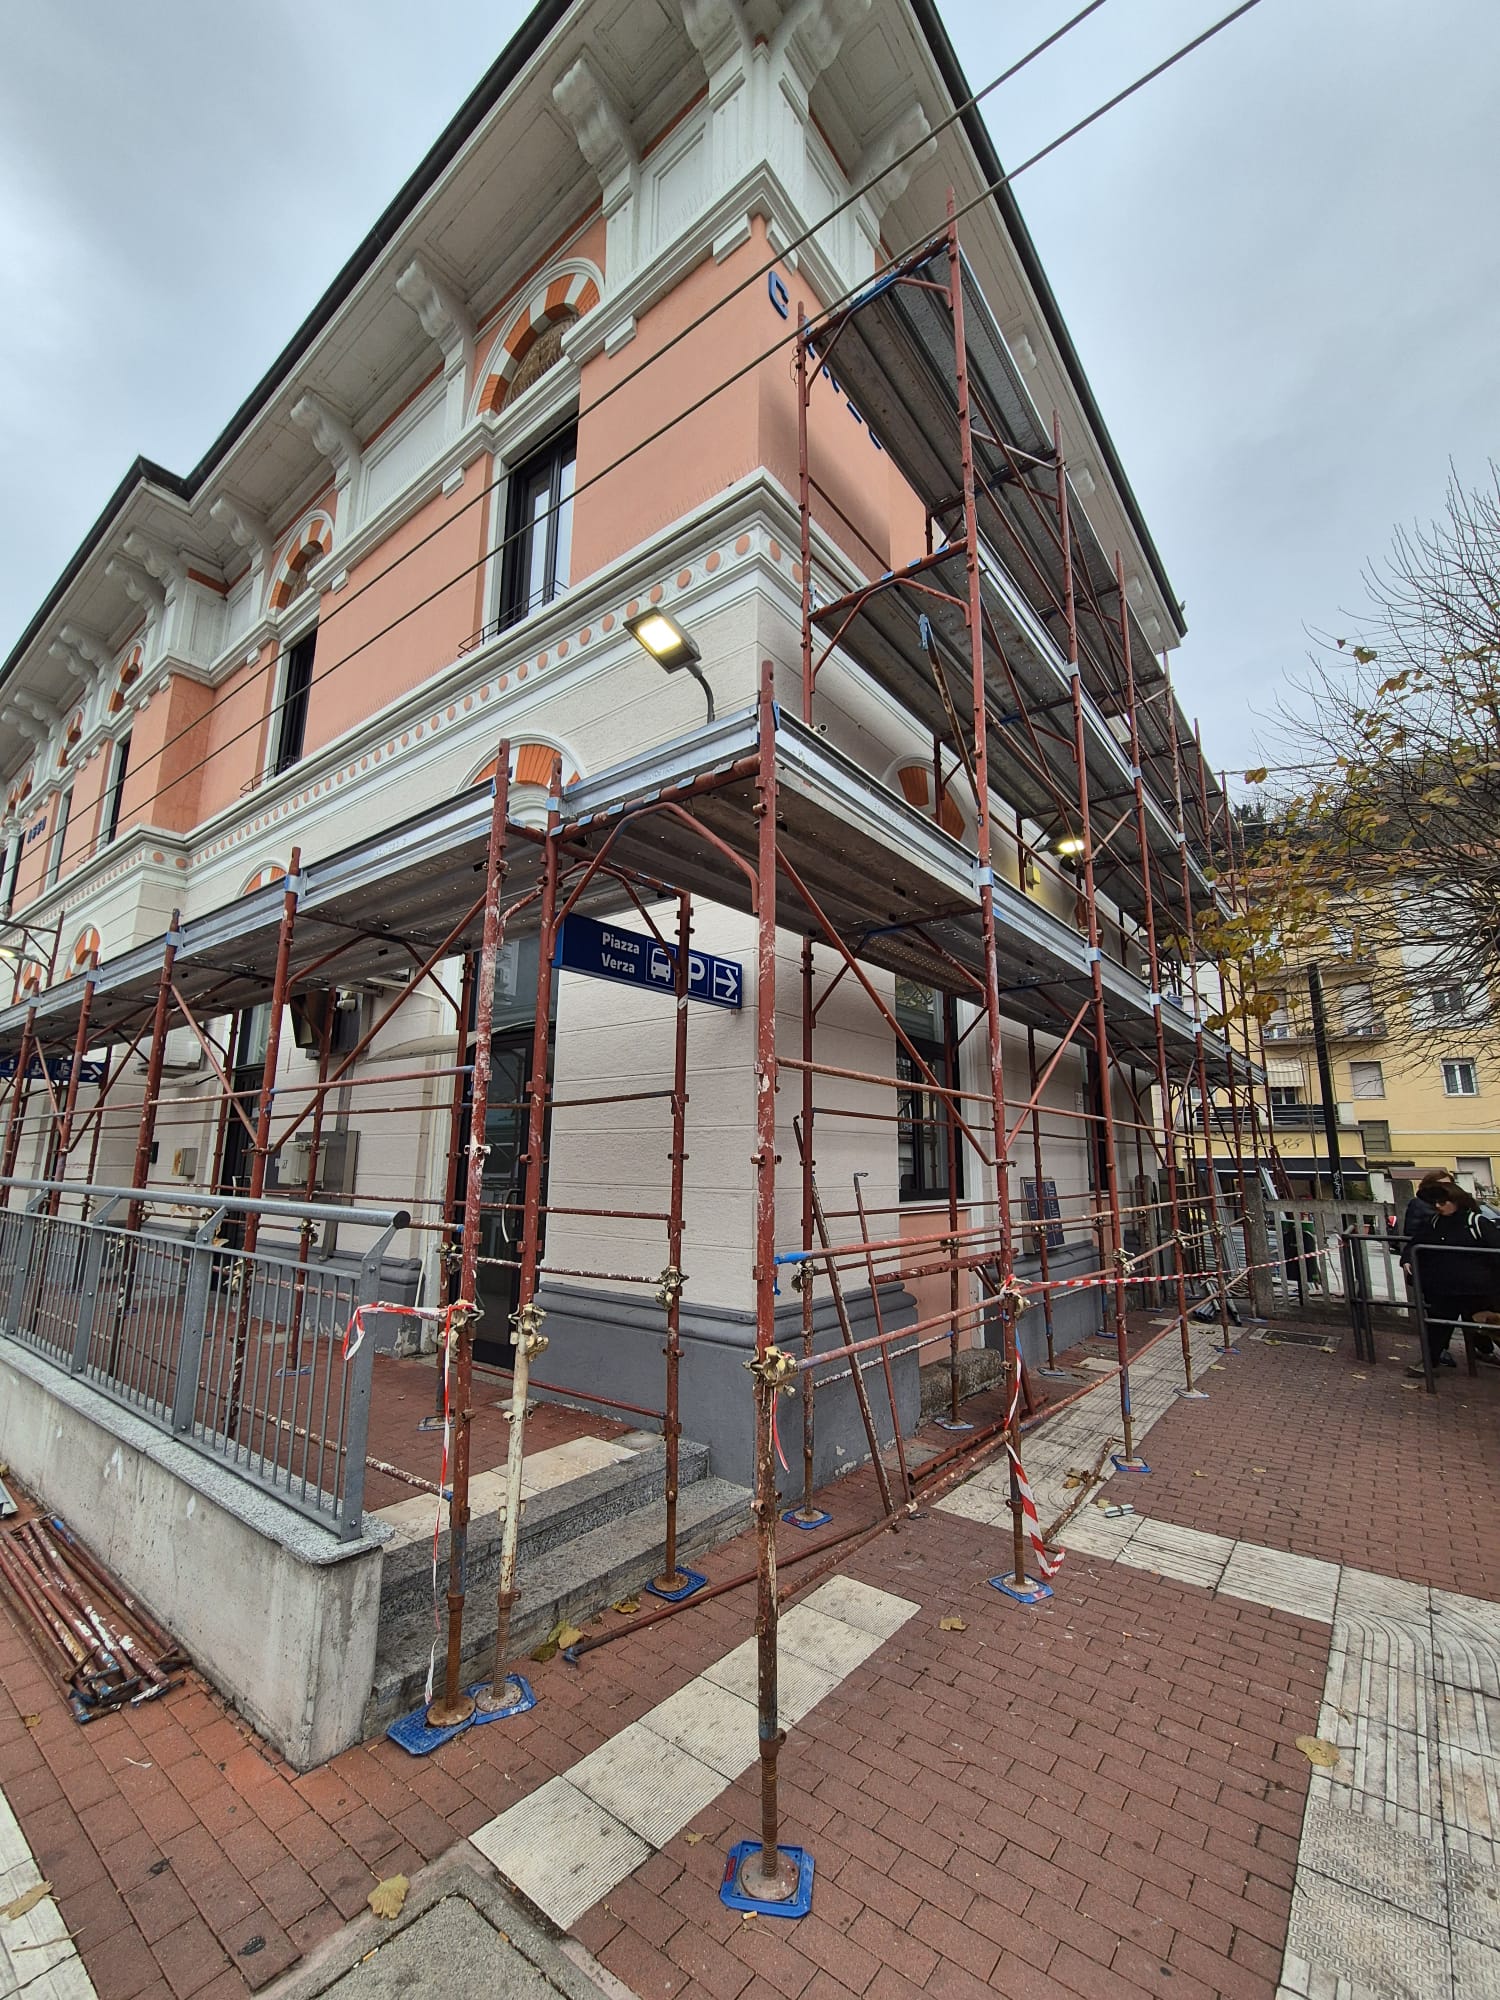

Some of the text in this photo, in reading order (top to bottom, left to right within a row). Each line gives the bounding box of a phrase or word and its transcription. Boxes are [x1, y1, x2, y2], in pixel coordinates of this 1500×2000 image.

[602, 932, 640, 955] Piazza
[602, 952, 635, 974] Verza
[688, 956, 706, 989] P
